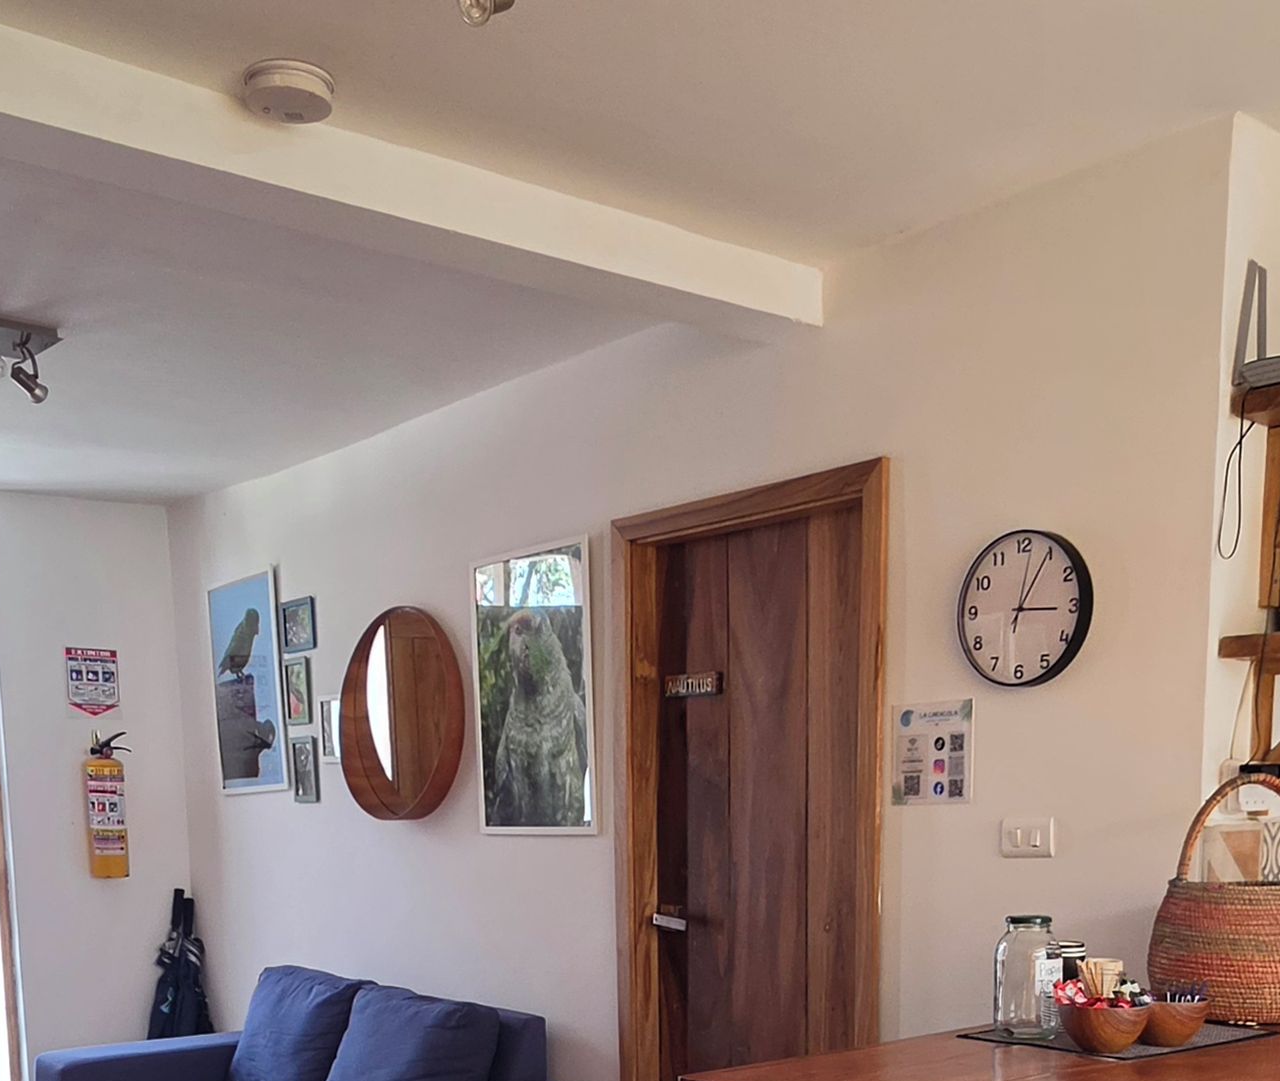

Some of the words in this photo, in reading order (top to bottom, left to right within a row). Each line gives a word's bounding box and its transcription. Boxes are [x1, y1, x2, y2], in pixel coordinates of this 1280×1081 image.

[1016, 537, 1032, 553] 12
[992, 551, 1005, 567] 11
[1063, 565, 1074, 582] 2
[976, 575, 991, 592] 10
[968, 605, 978, 621] 9
[1068, 597, 1080, 614] 3
[973, 635, 983, 651] 8
[1059, 630, 1069, 645] 4
[990, 656, 999, 672] 7
[1039, 654, 1050, 669] 5
[1013, 664, 1024, 679] 6
[665, 677, 712, 696] NAUTILUS
